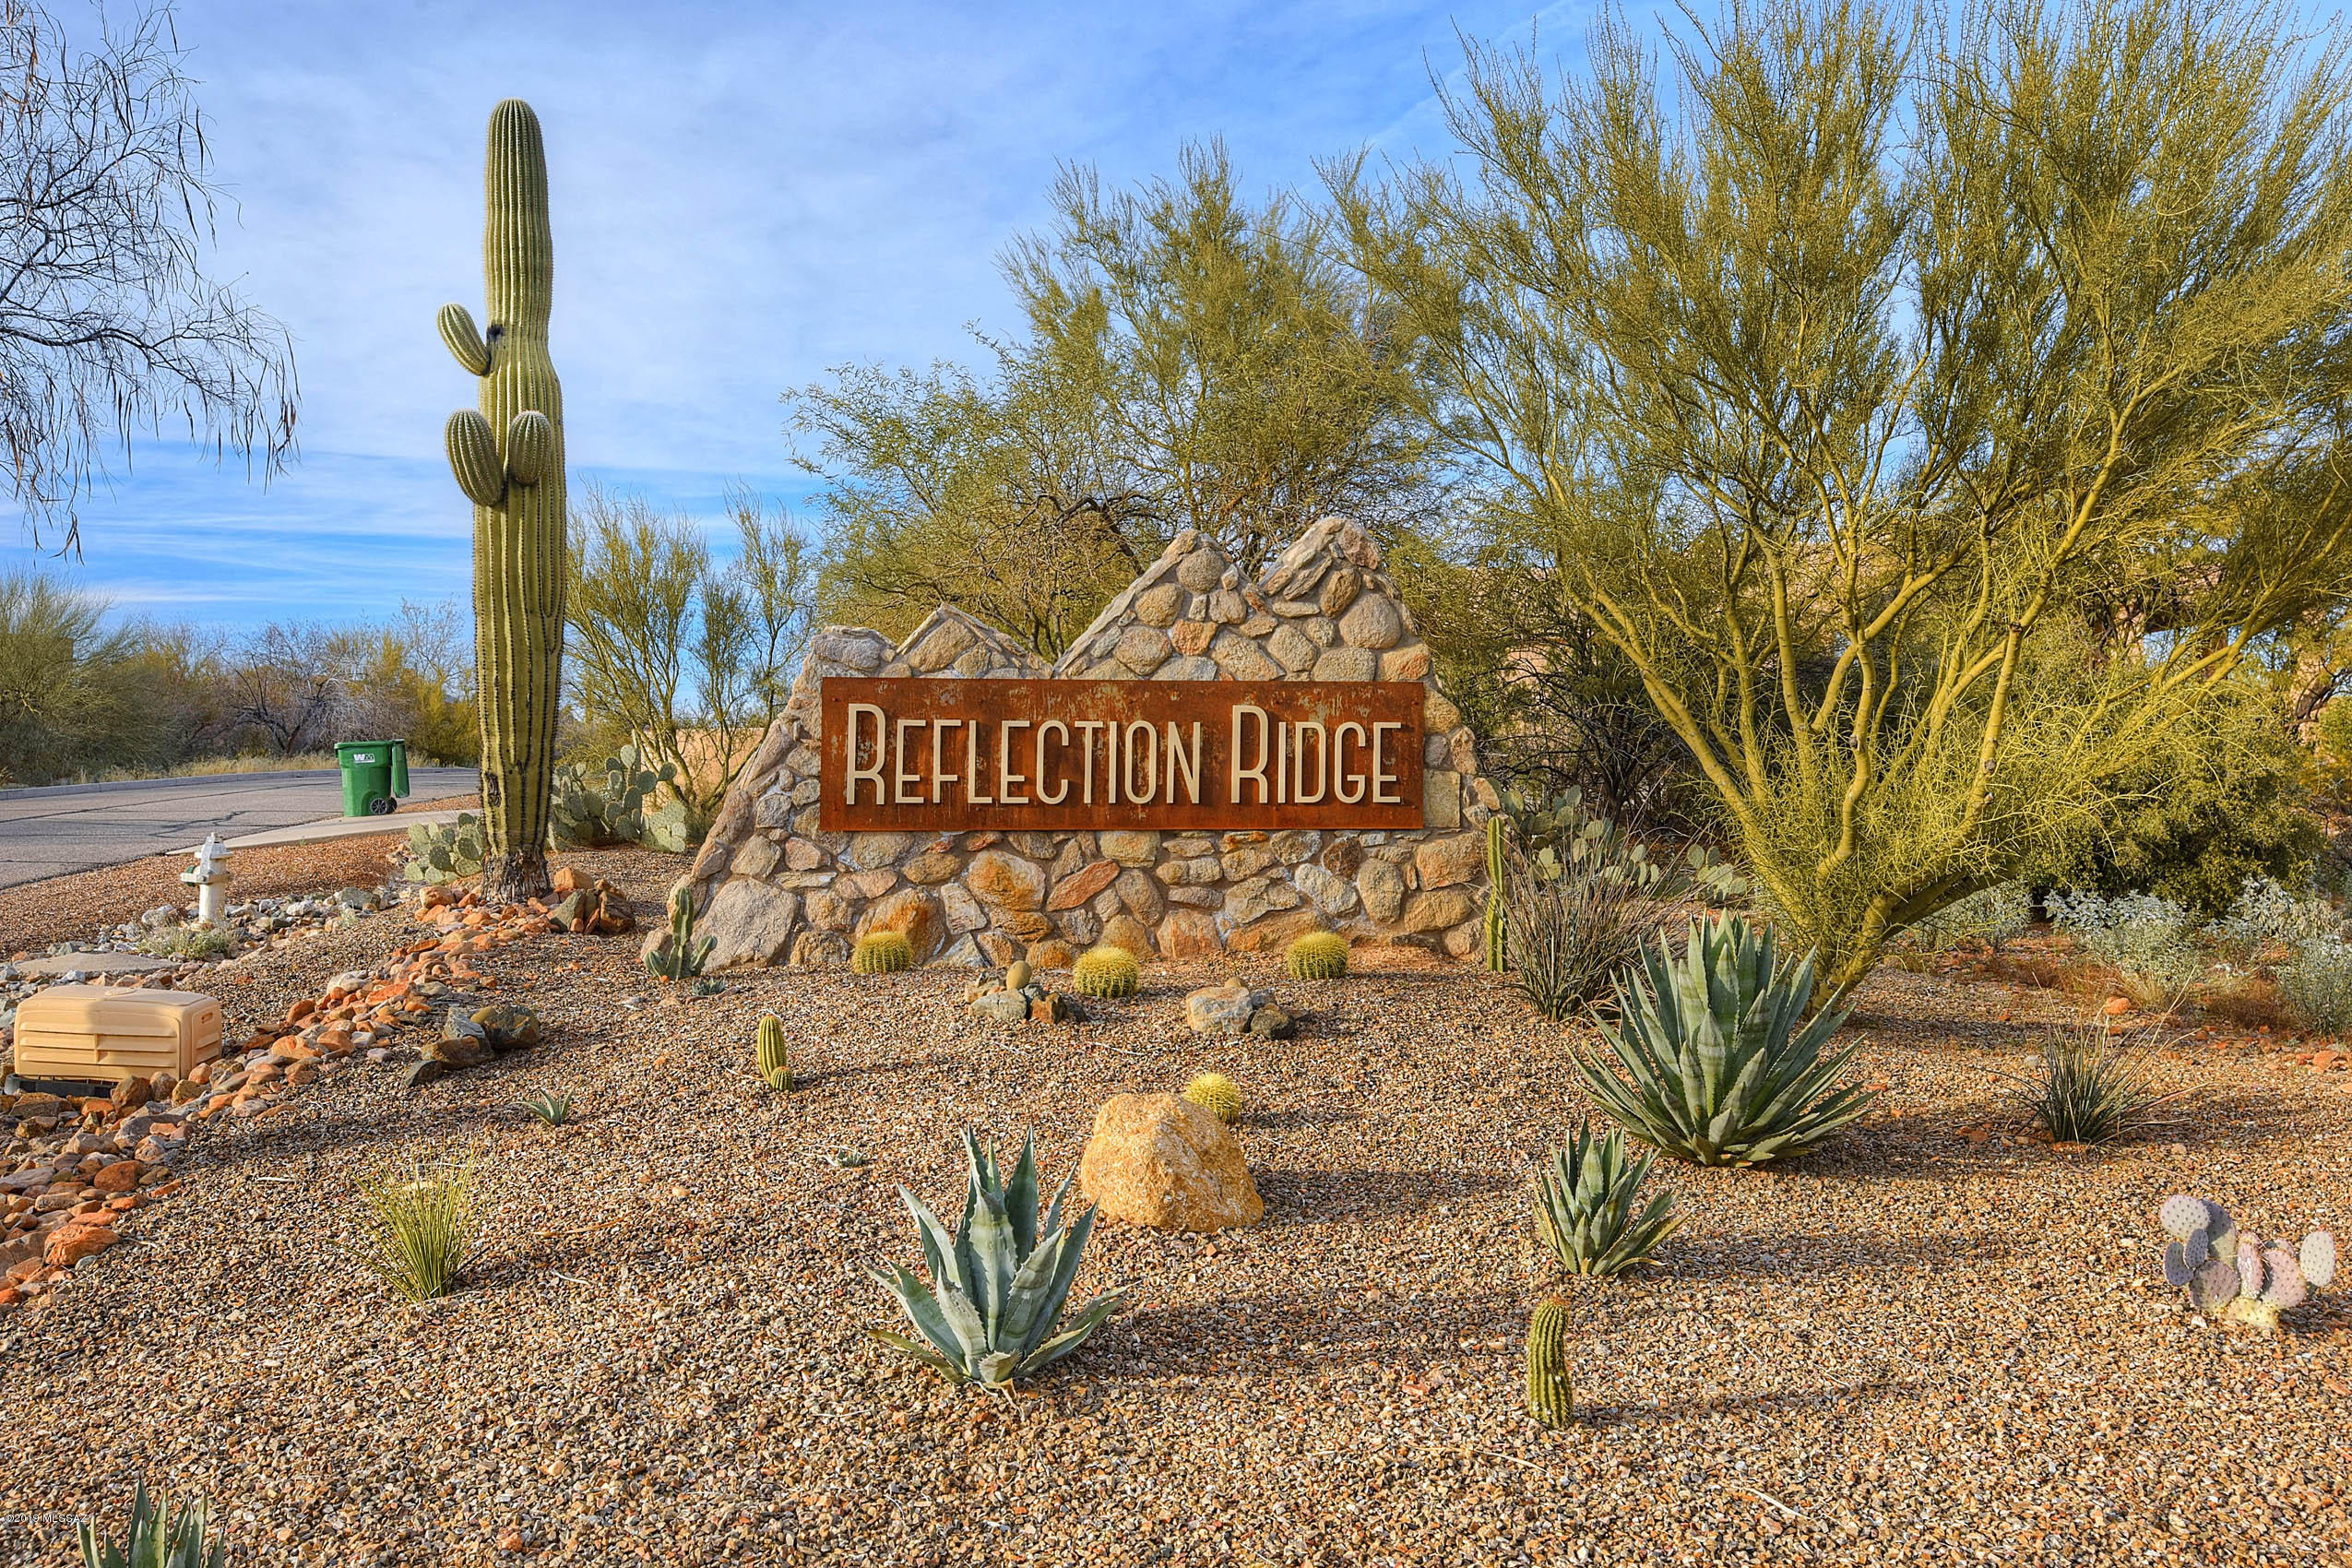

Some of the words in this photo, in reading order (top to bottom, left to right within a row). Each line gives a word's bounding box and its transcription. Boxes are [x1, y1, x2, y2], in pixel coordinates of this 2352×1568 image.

[353, 753, 375, 762] WM
[846, 703, 1201, 805] REFLECTION
[1230, 705, 1402, 804] RIDGE
